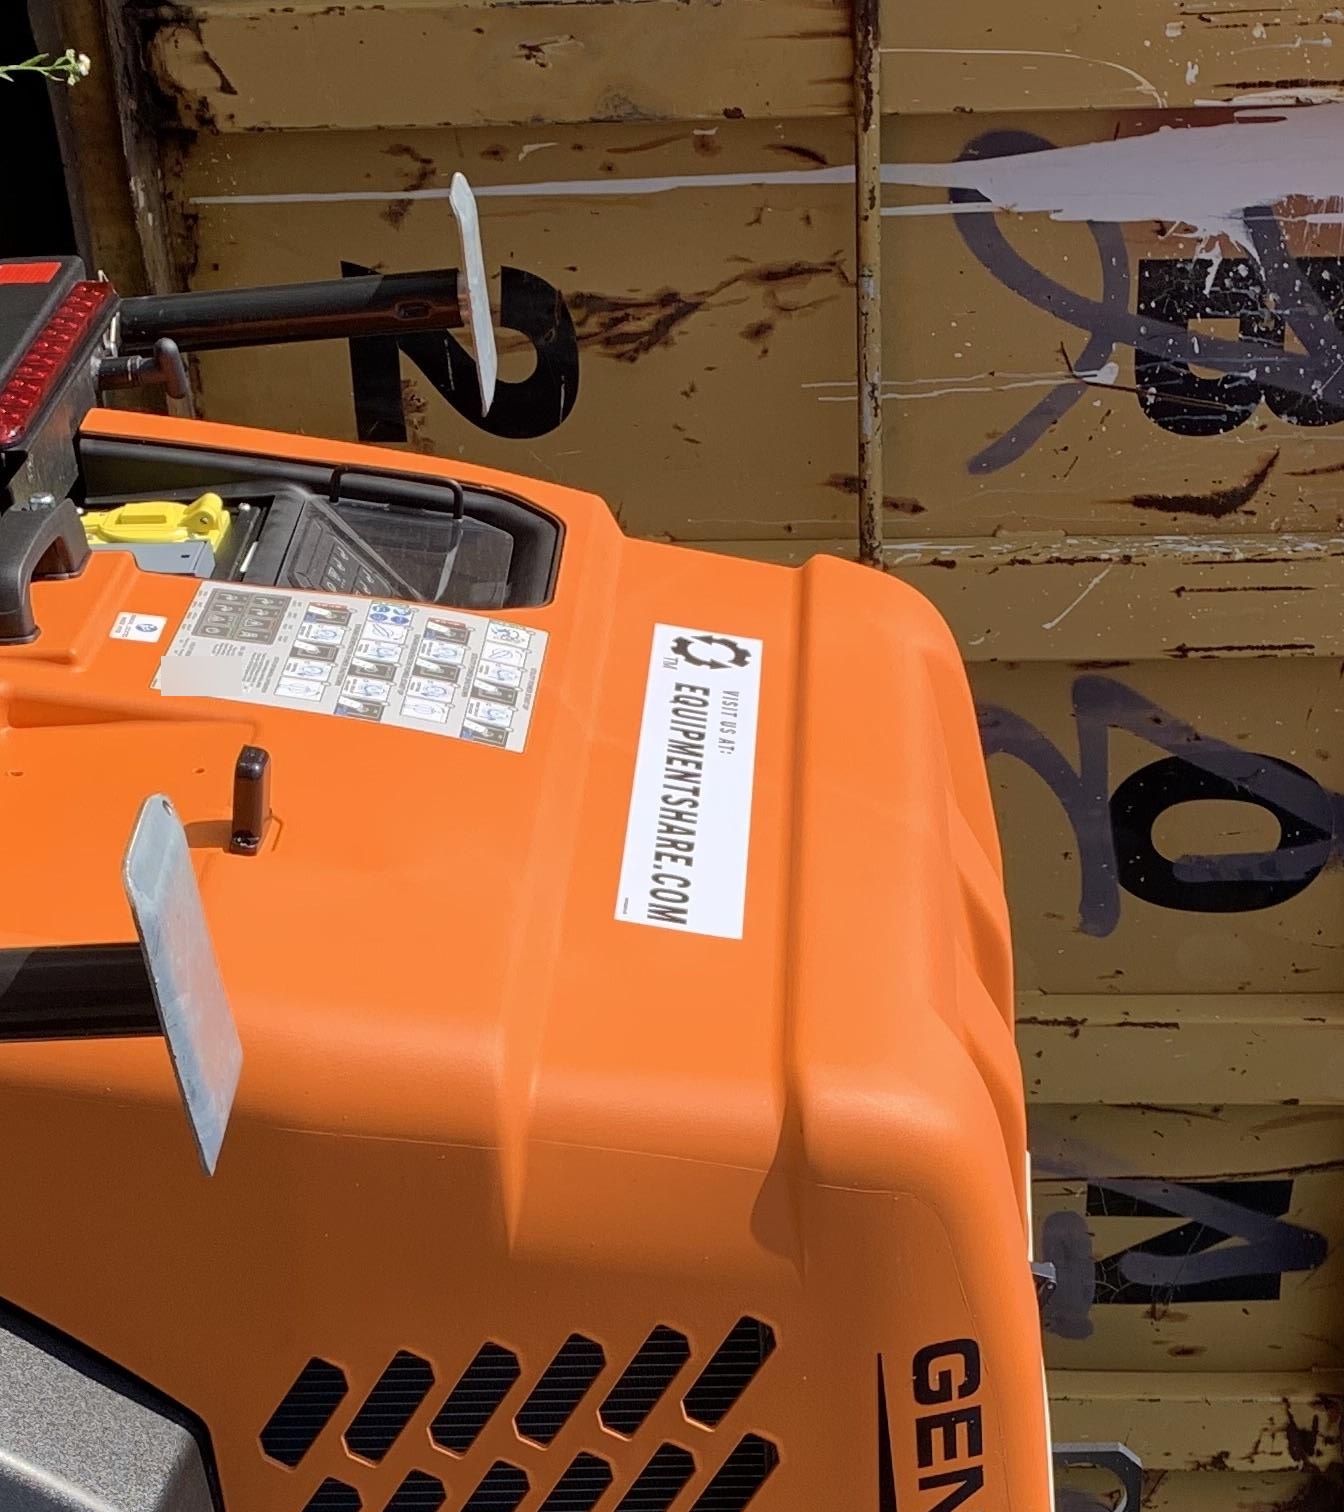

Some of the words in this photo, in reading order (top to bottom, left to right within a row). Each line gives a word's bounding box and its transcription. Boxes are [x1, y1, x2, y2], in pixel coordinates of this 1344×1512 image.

[340, 261, 580, 444] 2
[720, 690, 740, 718] VISIT
[718, 720, 736, 734] US
[717, 738, 734, 754] AT:
[646, 682, 711, 925] EQUIPMENTSHARE.COM
